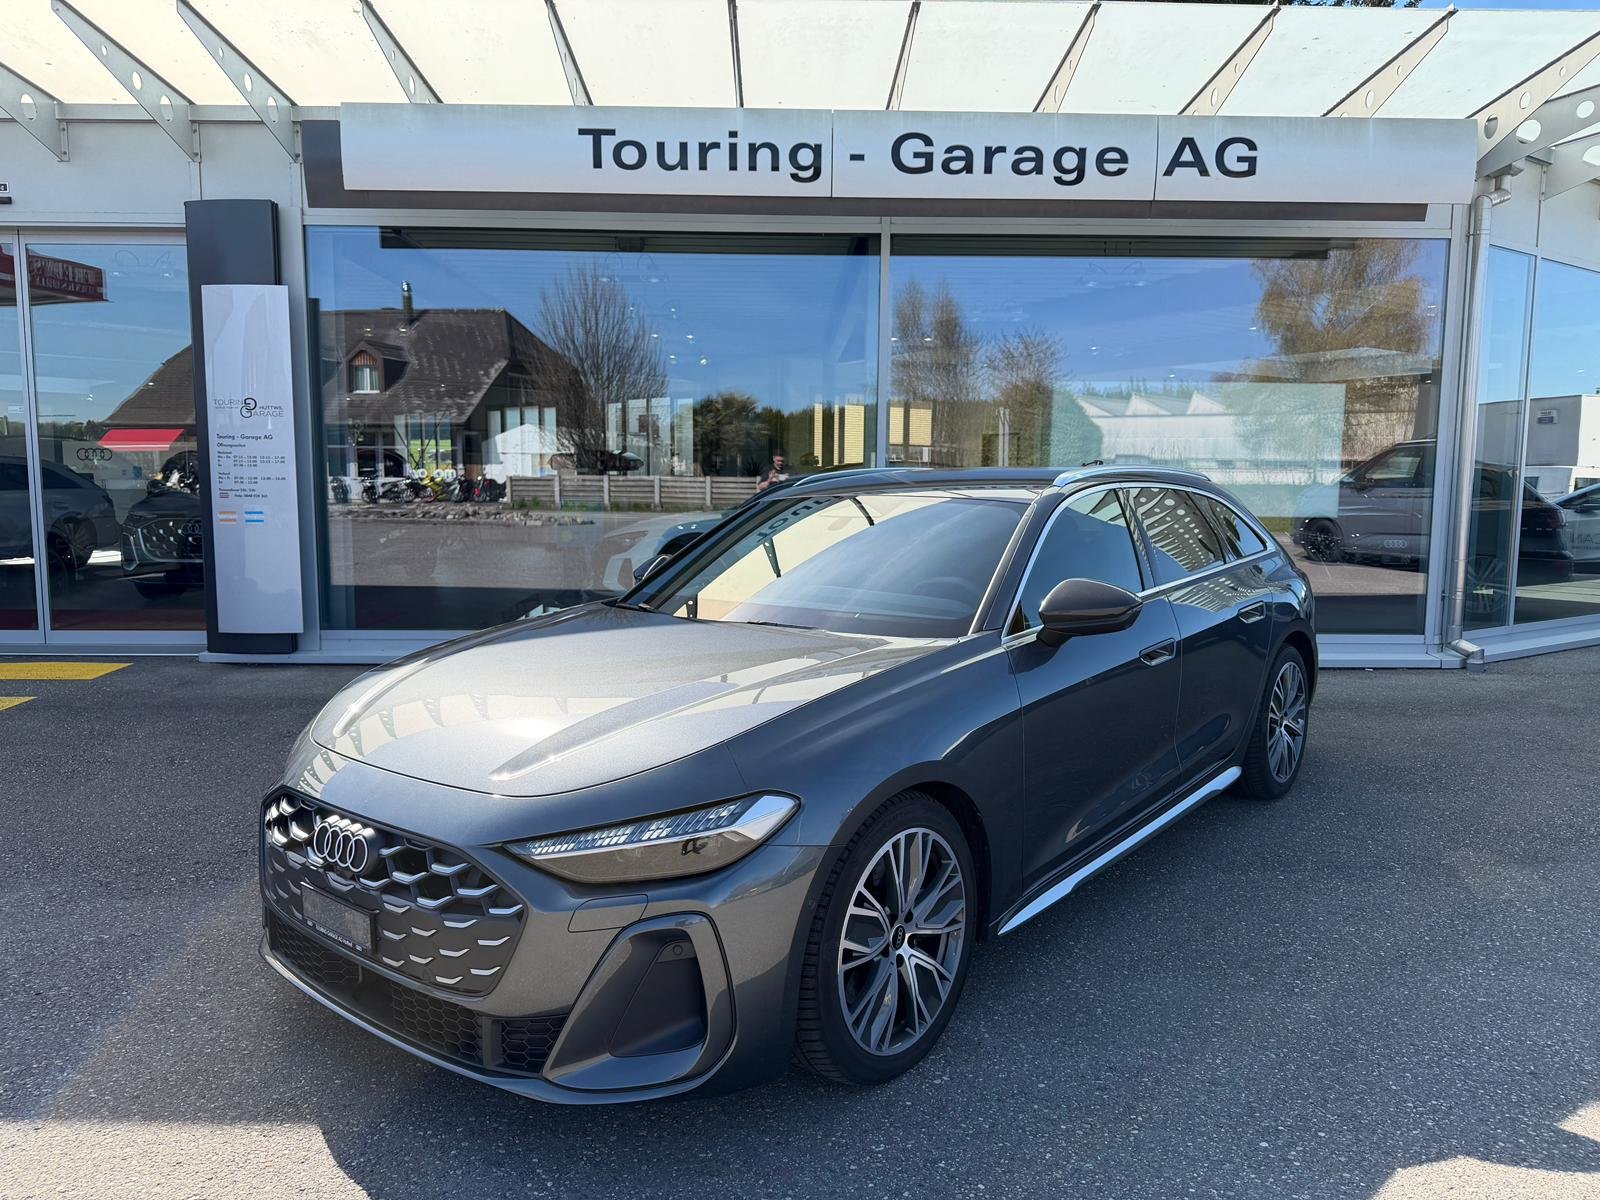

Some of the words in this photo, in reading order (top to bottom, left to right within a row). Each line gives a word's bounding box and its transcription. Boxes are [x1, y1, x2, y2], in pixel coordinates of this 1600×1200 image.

[577, 127, 822, 183] Touring
[890, 131, 1130, 187] Garage
[1162, 136, 1259, 179] AG
[240, 405, 285, 418] GARAGE
